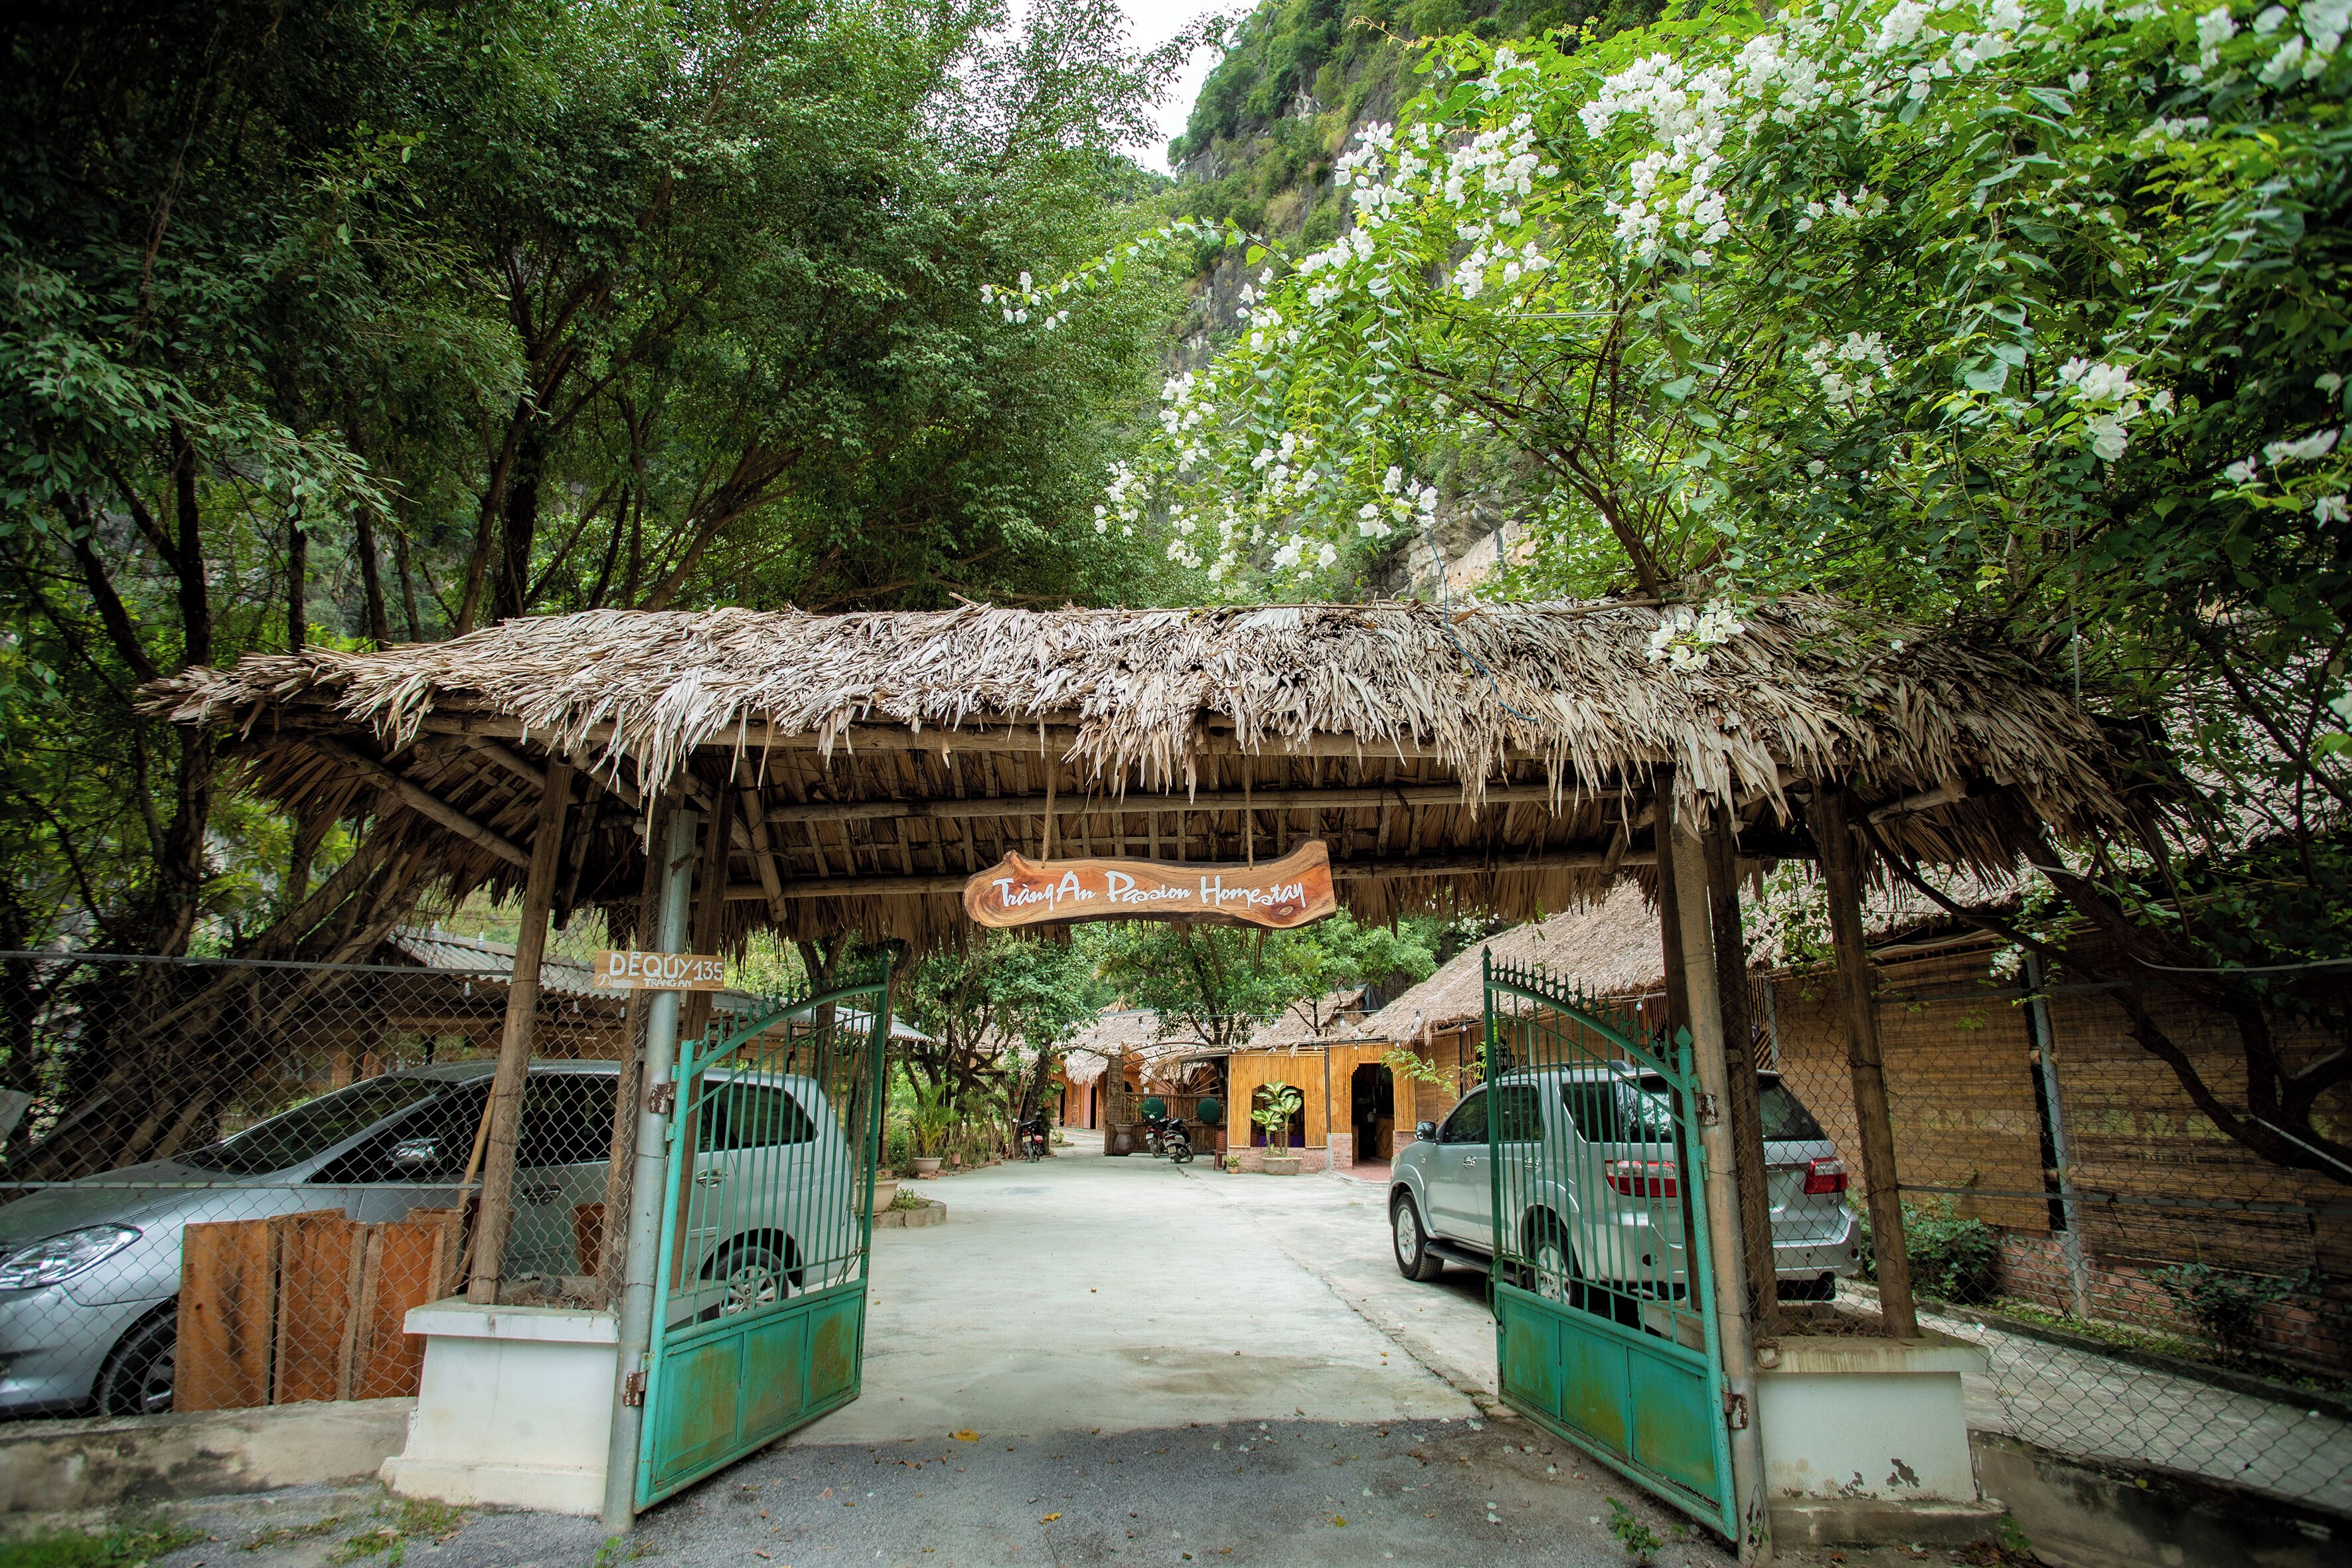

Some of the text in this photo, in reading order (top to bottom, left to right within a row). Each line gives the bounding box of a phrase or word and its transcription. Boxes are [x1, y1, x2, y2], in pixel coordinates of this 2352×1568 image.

[992, 870, 1306, 911] Tràng An Passion Homestay
[692, 961, 723, 981] 135
[677, 979, 692, 988] AN
